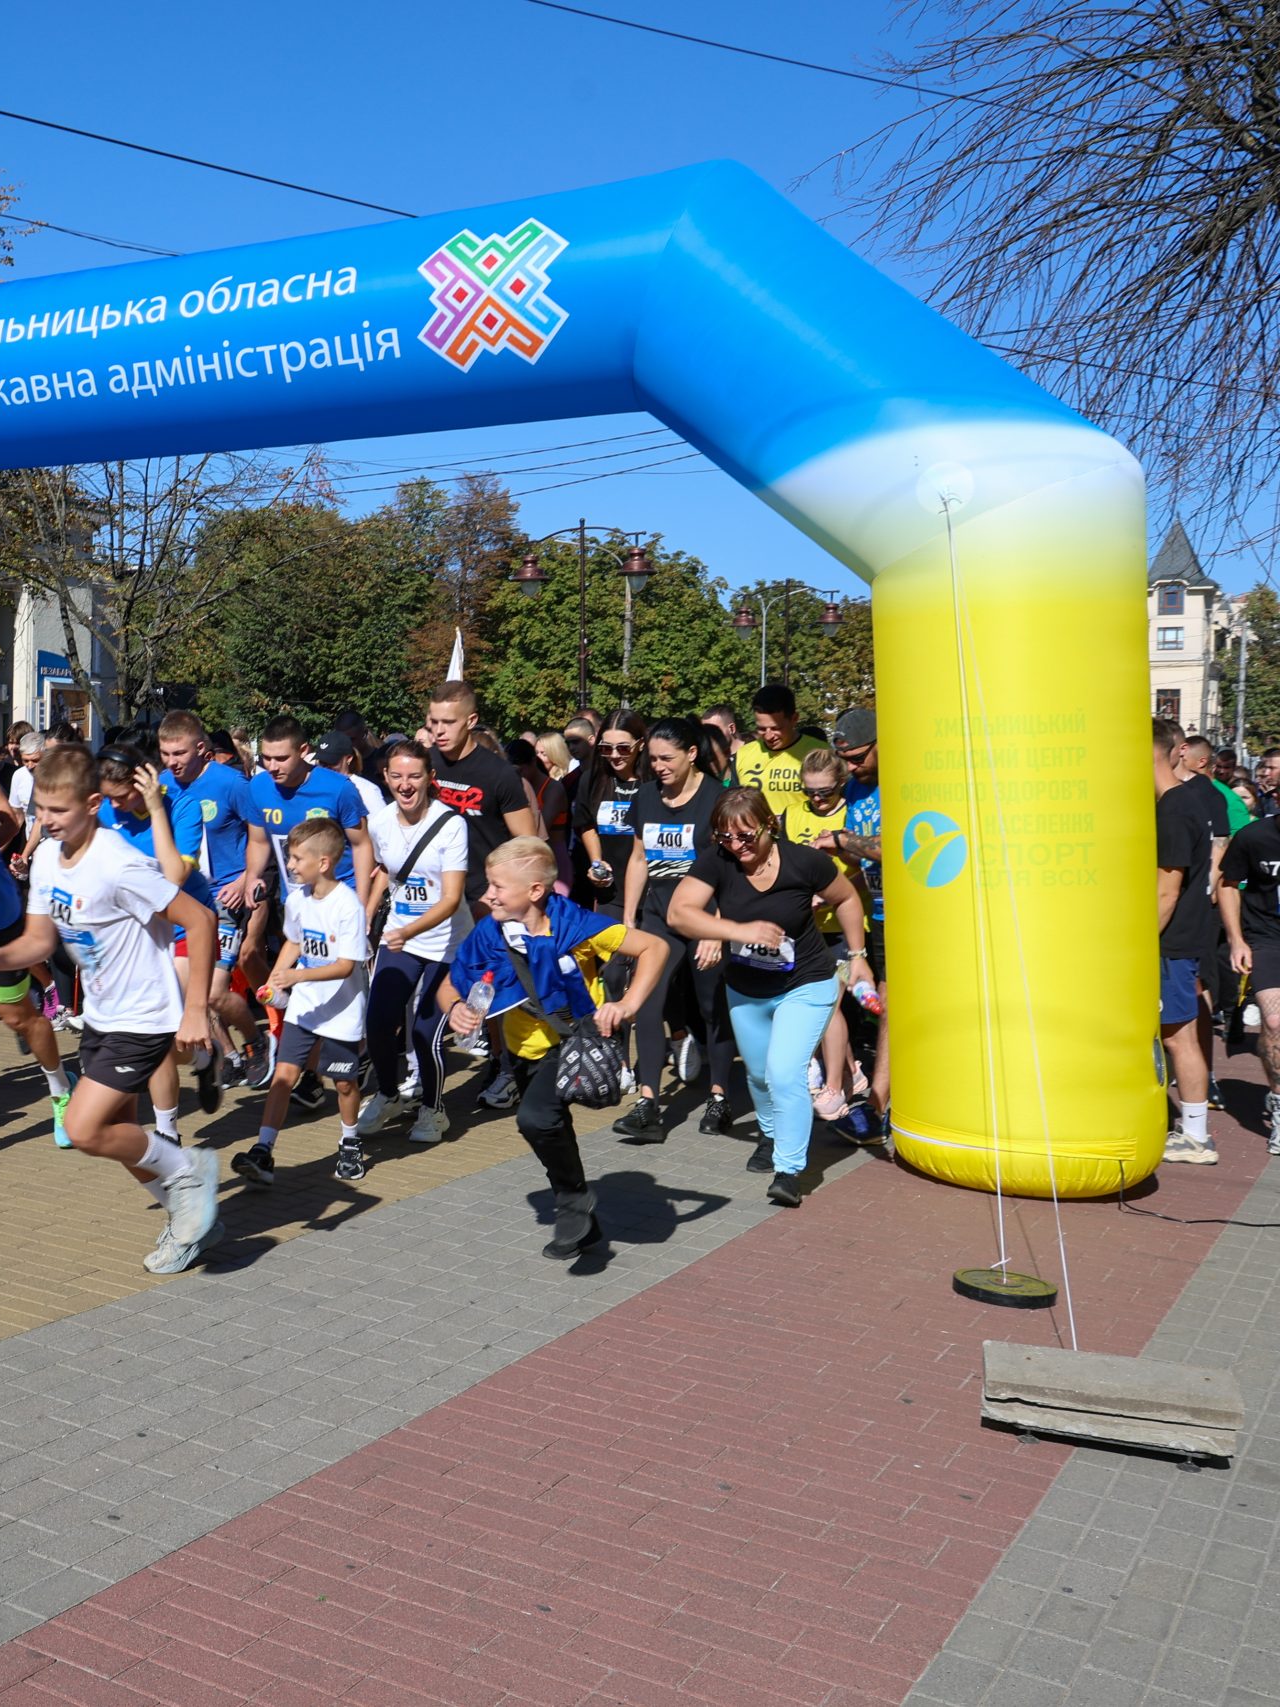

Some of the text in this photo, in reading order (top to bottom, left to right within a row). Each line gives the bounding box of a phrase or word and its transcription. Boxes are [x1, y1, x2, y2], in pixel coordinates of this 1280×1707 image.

[179, 265, 358, 319] обласна
[108, 320, 402, 399] адміністрація
[923, 743, 1088, 772] ОБЛАСНИЙ ЦЕНТР
[769, 768, 801, 780] IRON
[768, 781, 802, 792] CLUB
[262, 808, 283, 825] 70
[984, 812, 1095, 835] НАСЕЛЕННЯ
[656, 832, 683, 848] 400
[976, 842, 1096, 867] СПОРТ
[1040, 868, 1099, 888] ВСІХ
[405, 885, 428, 901] 379
[326, 1061, 354, 1074] NIKE
